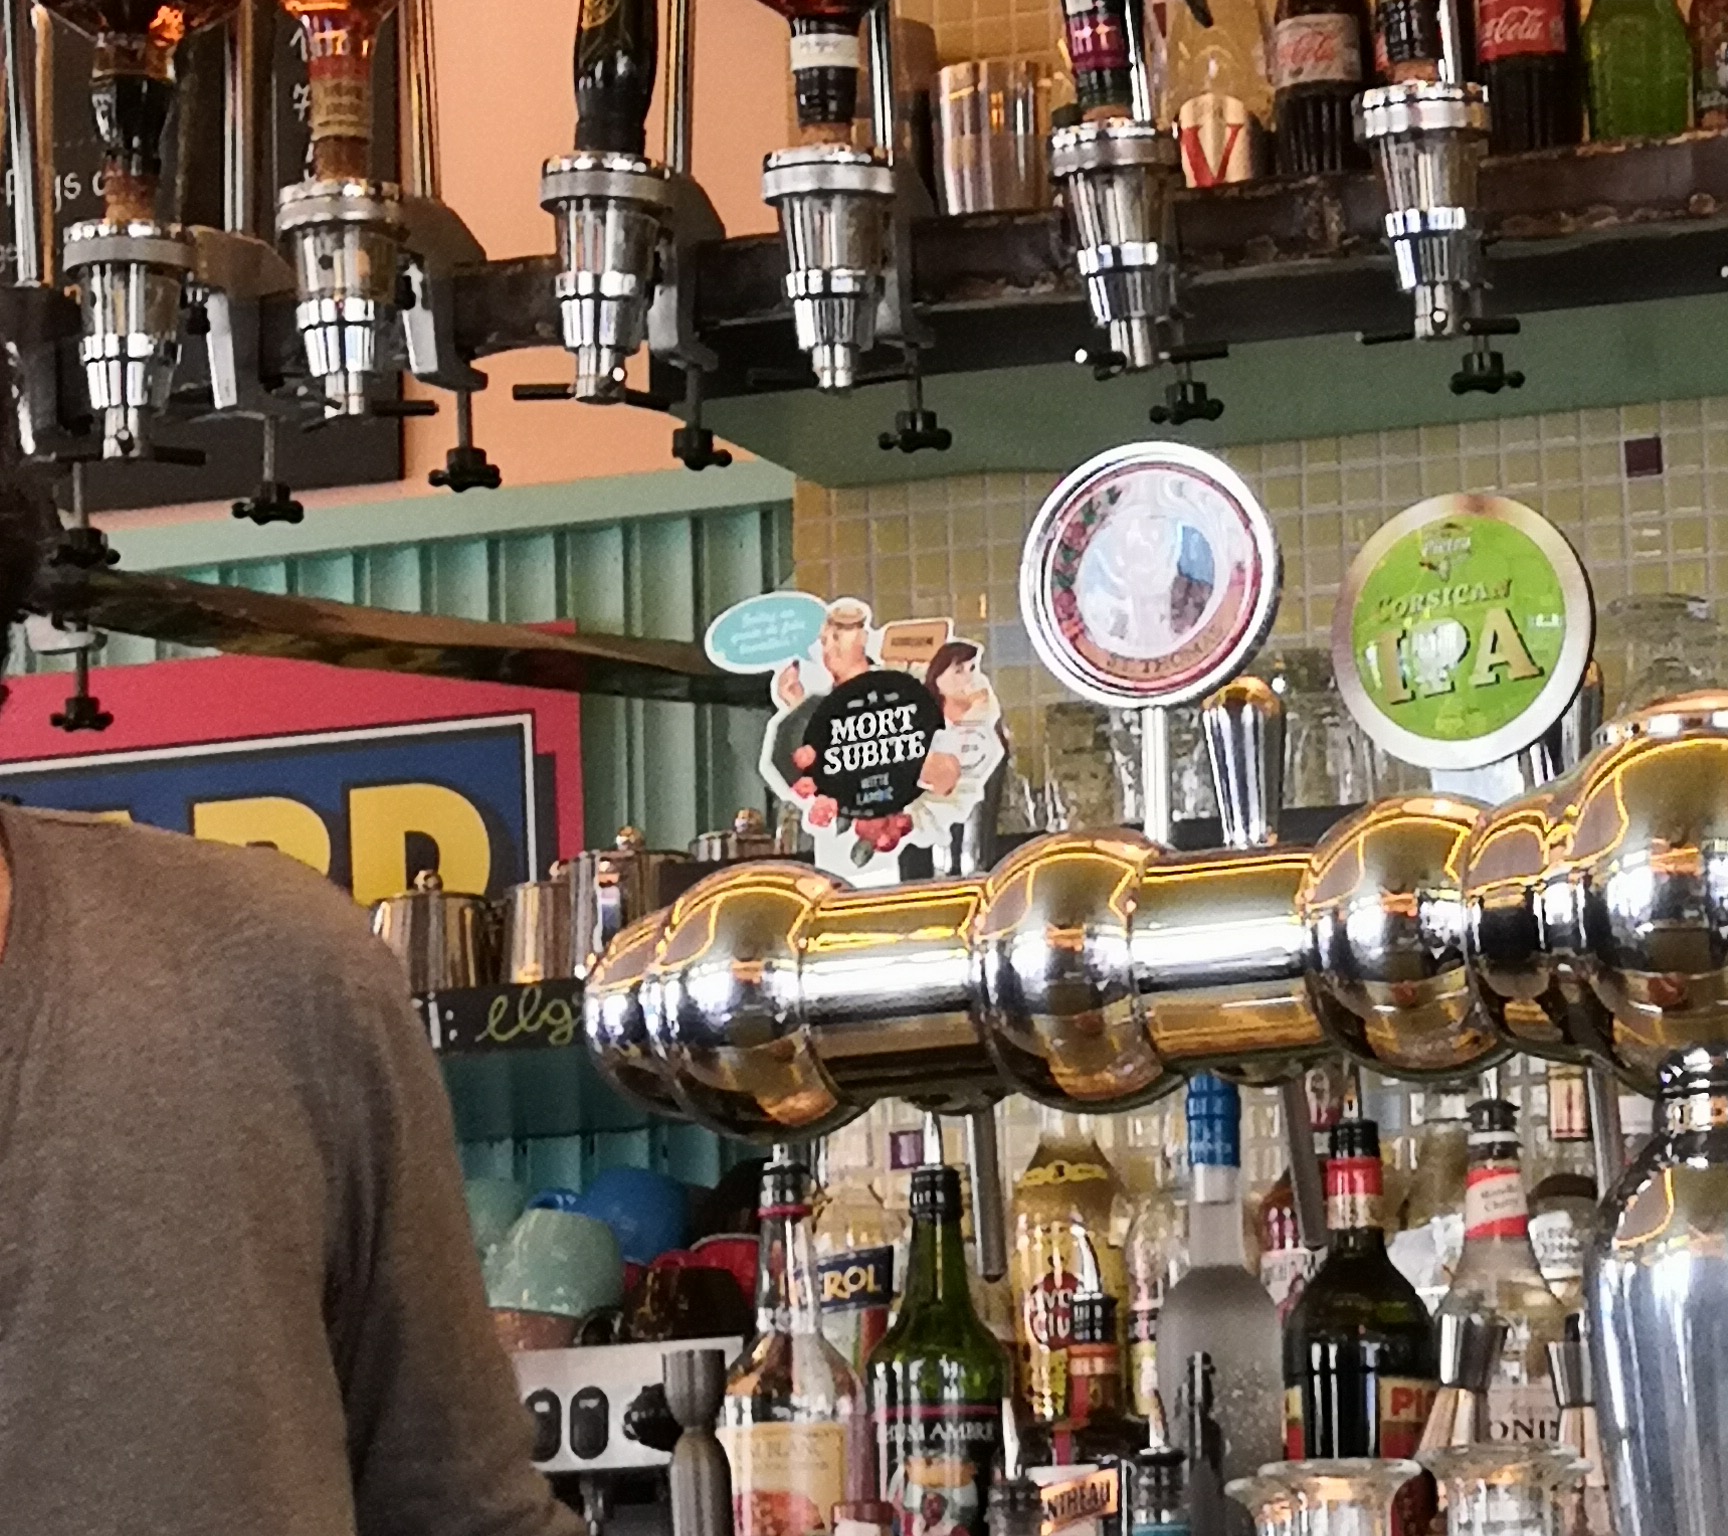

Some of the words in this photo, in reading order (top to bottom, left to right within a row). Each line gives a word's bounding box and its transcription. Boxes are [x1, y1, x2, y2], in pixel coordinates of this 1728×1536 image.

[1376, 607, 1545, 705] IPA
[830, 704, 918, 746] MORT
[823, 730, 927, 776] SUBITE
